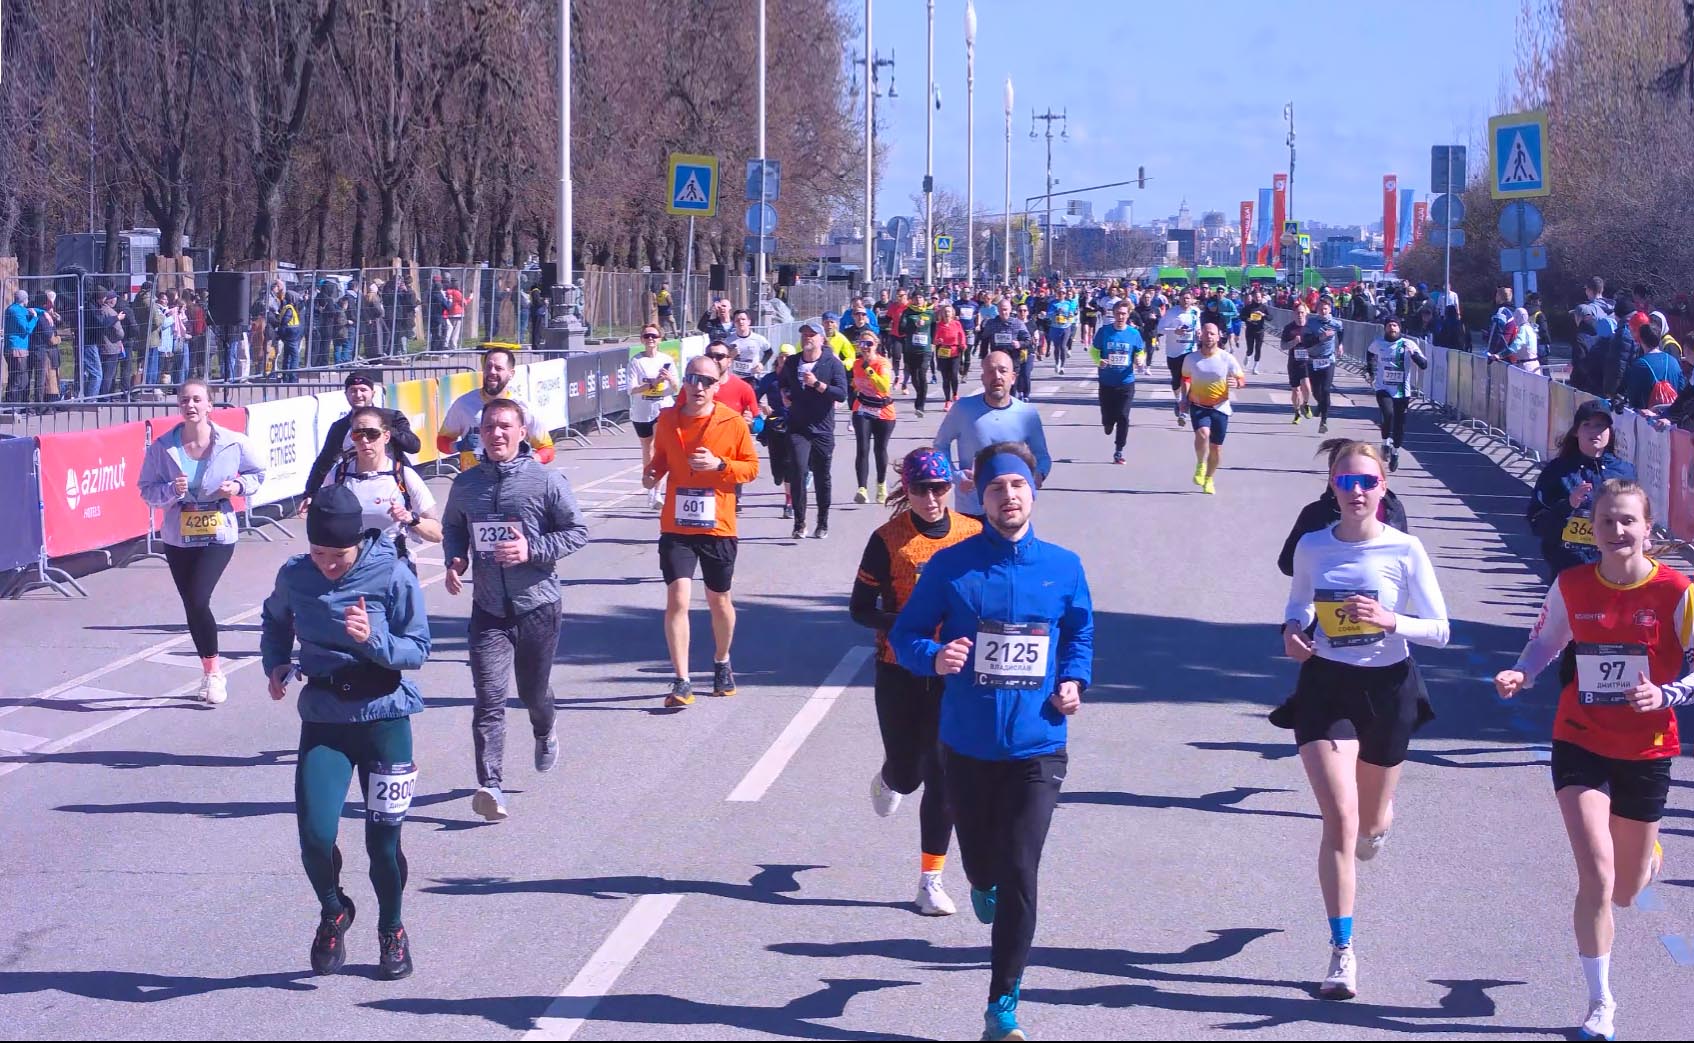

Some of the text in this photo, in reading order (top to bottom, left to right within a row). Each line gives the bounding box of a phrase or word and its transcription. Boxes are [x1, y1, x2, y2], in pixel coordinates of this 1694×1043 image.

[270, 419, 296, 444] CROCUS
[270, 442, 296, 468] FITNESS
[81, 456, 126, 496] azimut
[683, 500, 705, 513] 601
[185, 515, 217, 528] 4205
[984, 640, 1039, 663] 2125
[989, 663, 1032, 671] ВЛАДИСЛАВ
[1599, 661, 1626, 680] 97
[1597, 681, 1631, 689] ДМИТРИЙ
[1585, 692, 1594, 703] B
[376, 779, 415, 801] 2800
